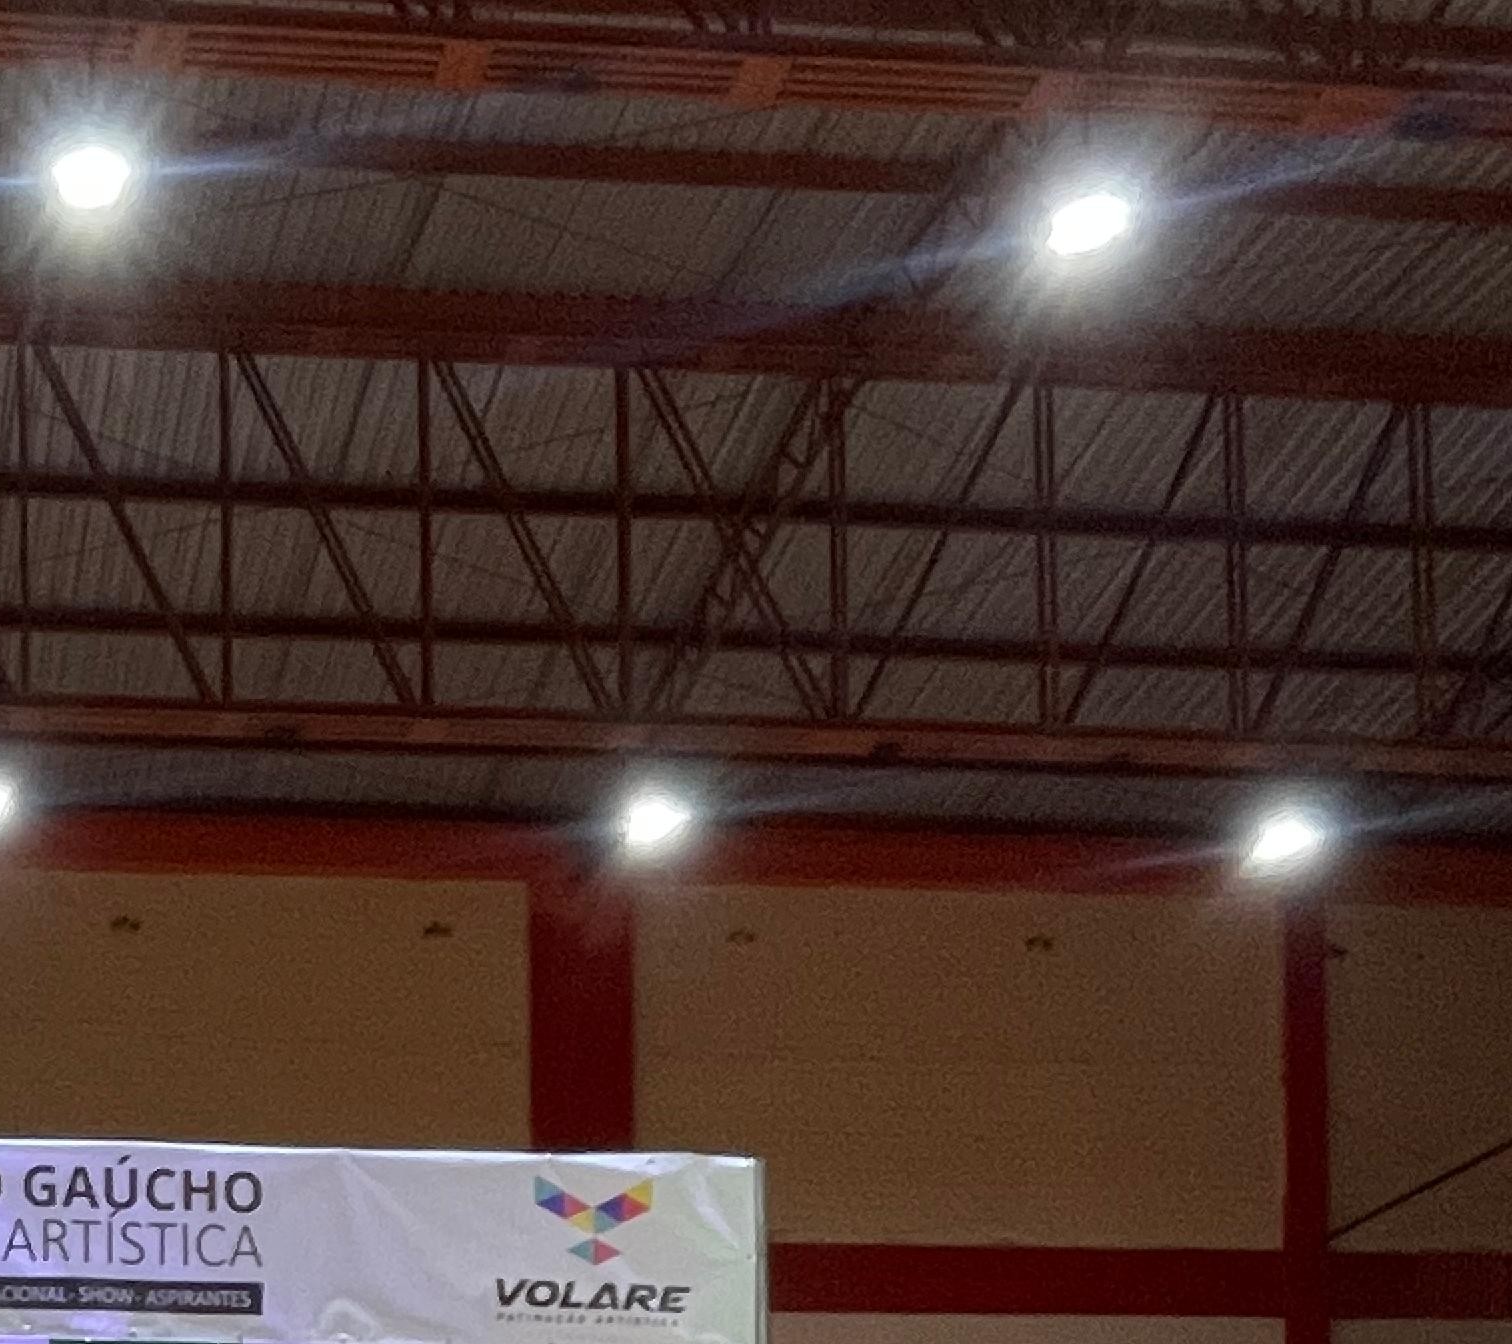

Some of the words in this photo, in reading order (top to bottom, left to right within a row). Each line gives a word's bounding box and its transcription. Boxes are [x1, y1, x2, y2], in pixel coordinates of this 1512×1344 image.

[24, 1154, 263, 1214] GAÚCHO
[1, 1208, 263, 1268] ARTÍSTICA
[79, 1286, 134, 1304] SHOW
[145, 1289, 252, 1308] ASPIRANTES
[496, 1278, 691, 1314] VOLARE
